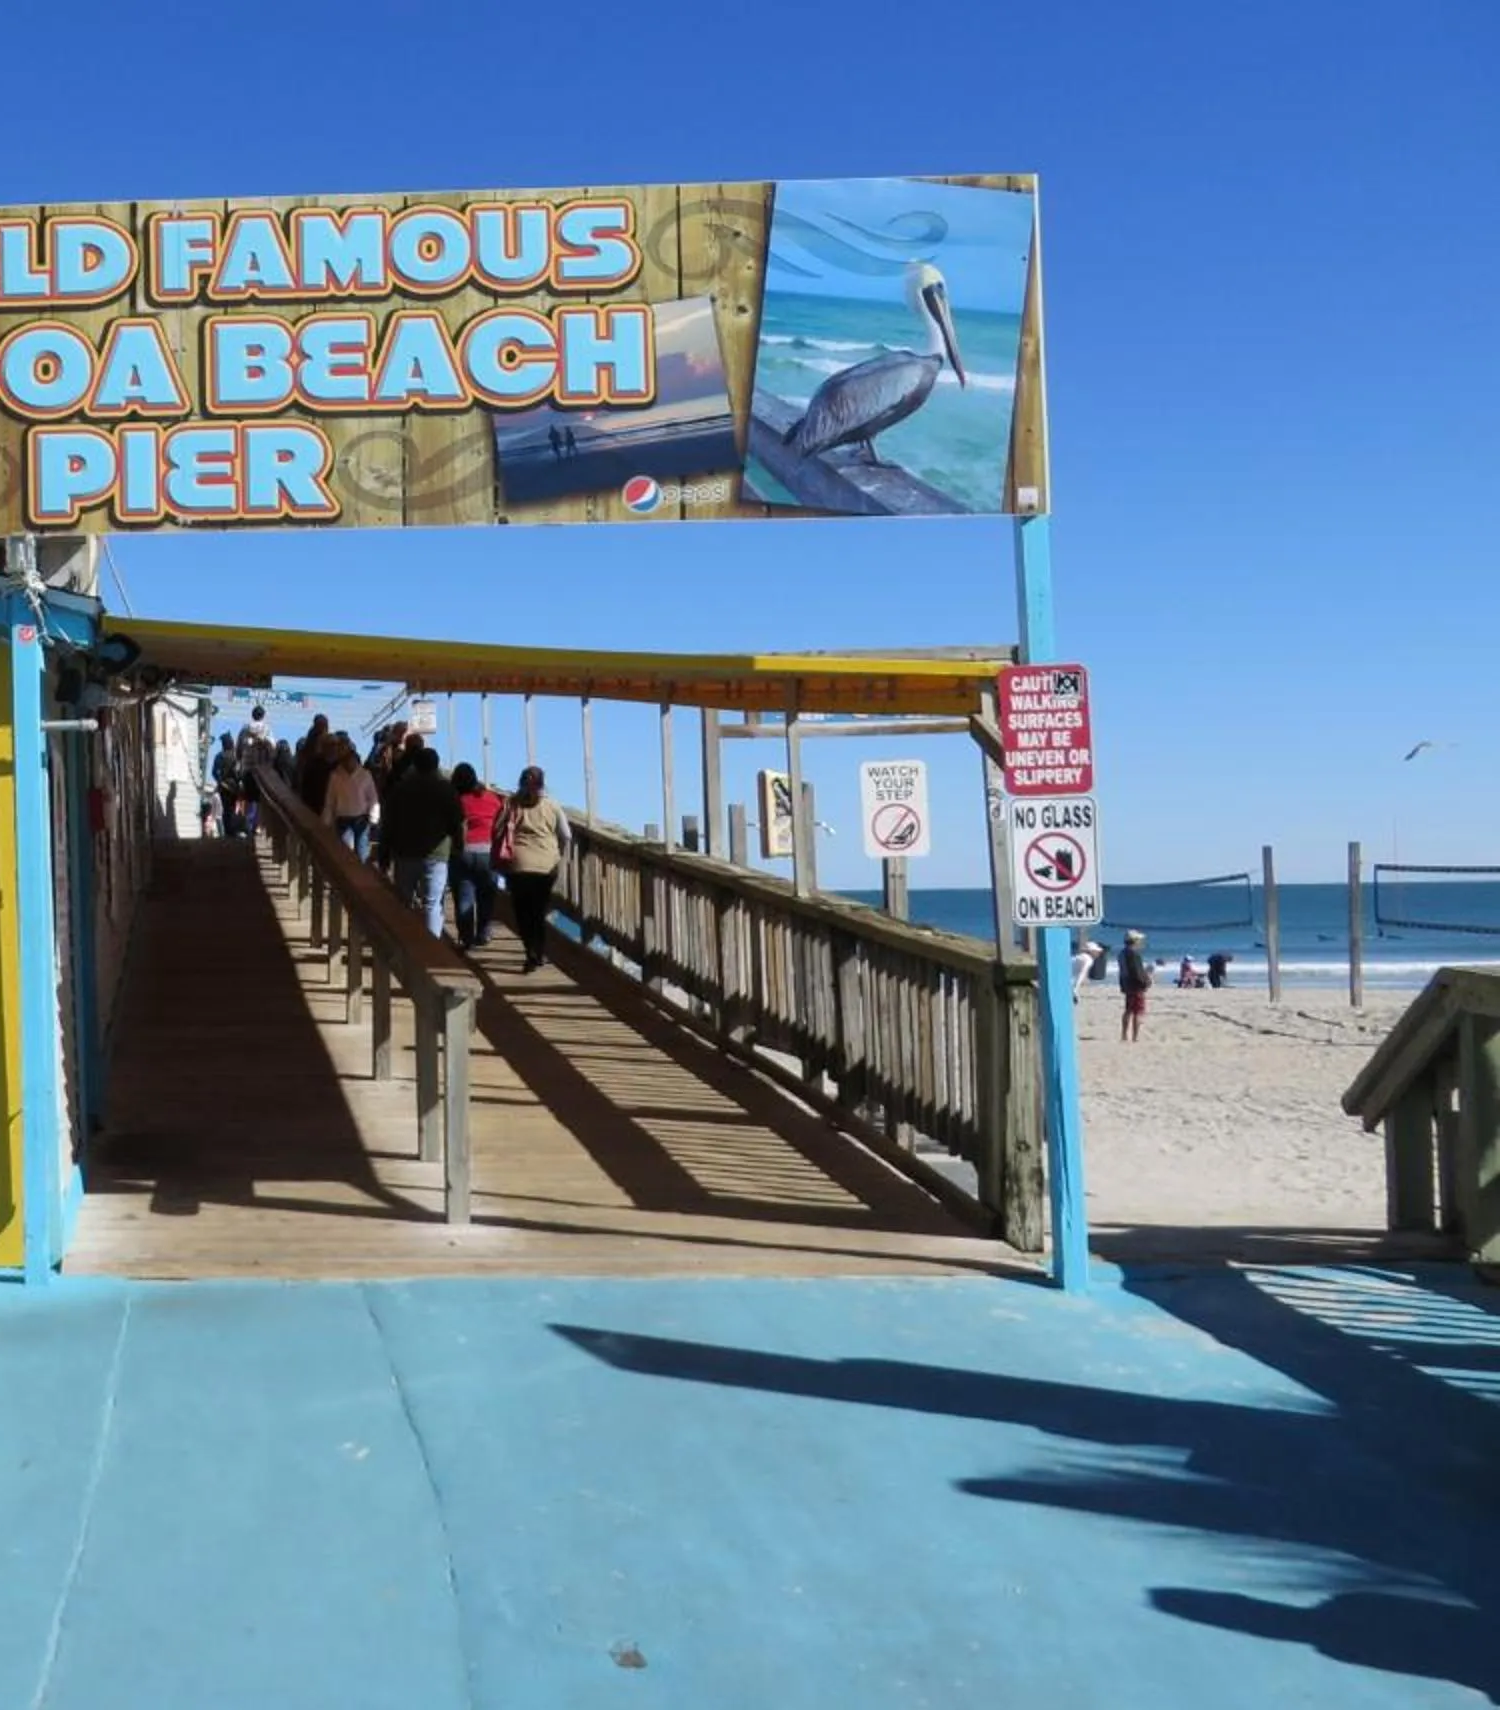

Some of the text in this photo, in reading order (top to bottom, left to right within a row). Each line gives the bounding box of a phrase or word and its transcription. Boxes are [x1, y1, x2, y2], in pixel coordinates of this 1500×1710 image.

[153, 202, 638, 302] FAMOUS
[209, 306, 653, 408] BEACH
[30, 423, 337, 522] PIER
[662, 482, 725, 506] pepsi
[1008, 711, 1083, 730] SURFACES
[1017, 731, 1072, 749] MAY BE
[1005, 750, 1090, 767] UNEVEN OR
[868, 766, 919, 777] WATCH
[1013, 768, 1082, 786] SLIPPERY
[873, 778, 915, 789] YOUR
[875, 789, 913, 801] STEP
[1015, 805, 1093, 830] NO GLASS
[1018, 894, 1096, 919] ON BEACH
